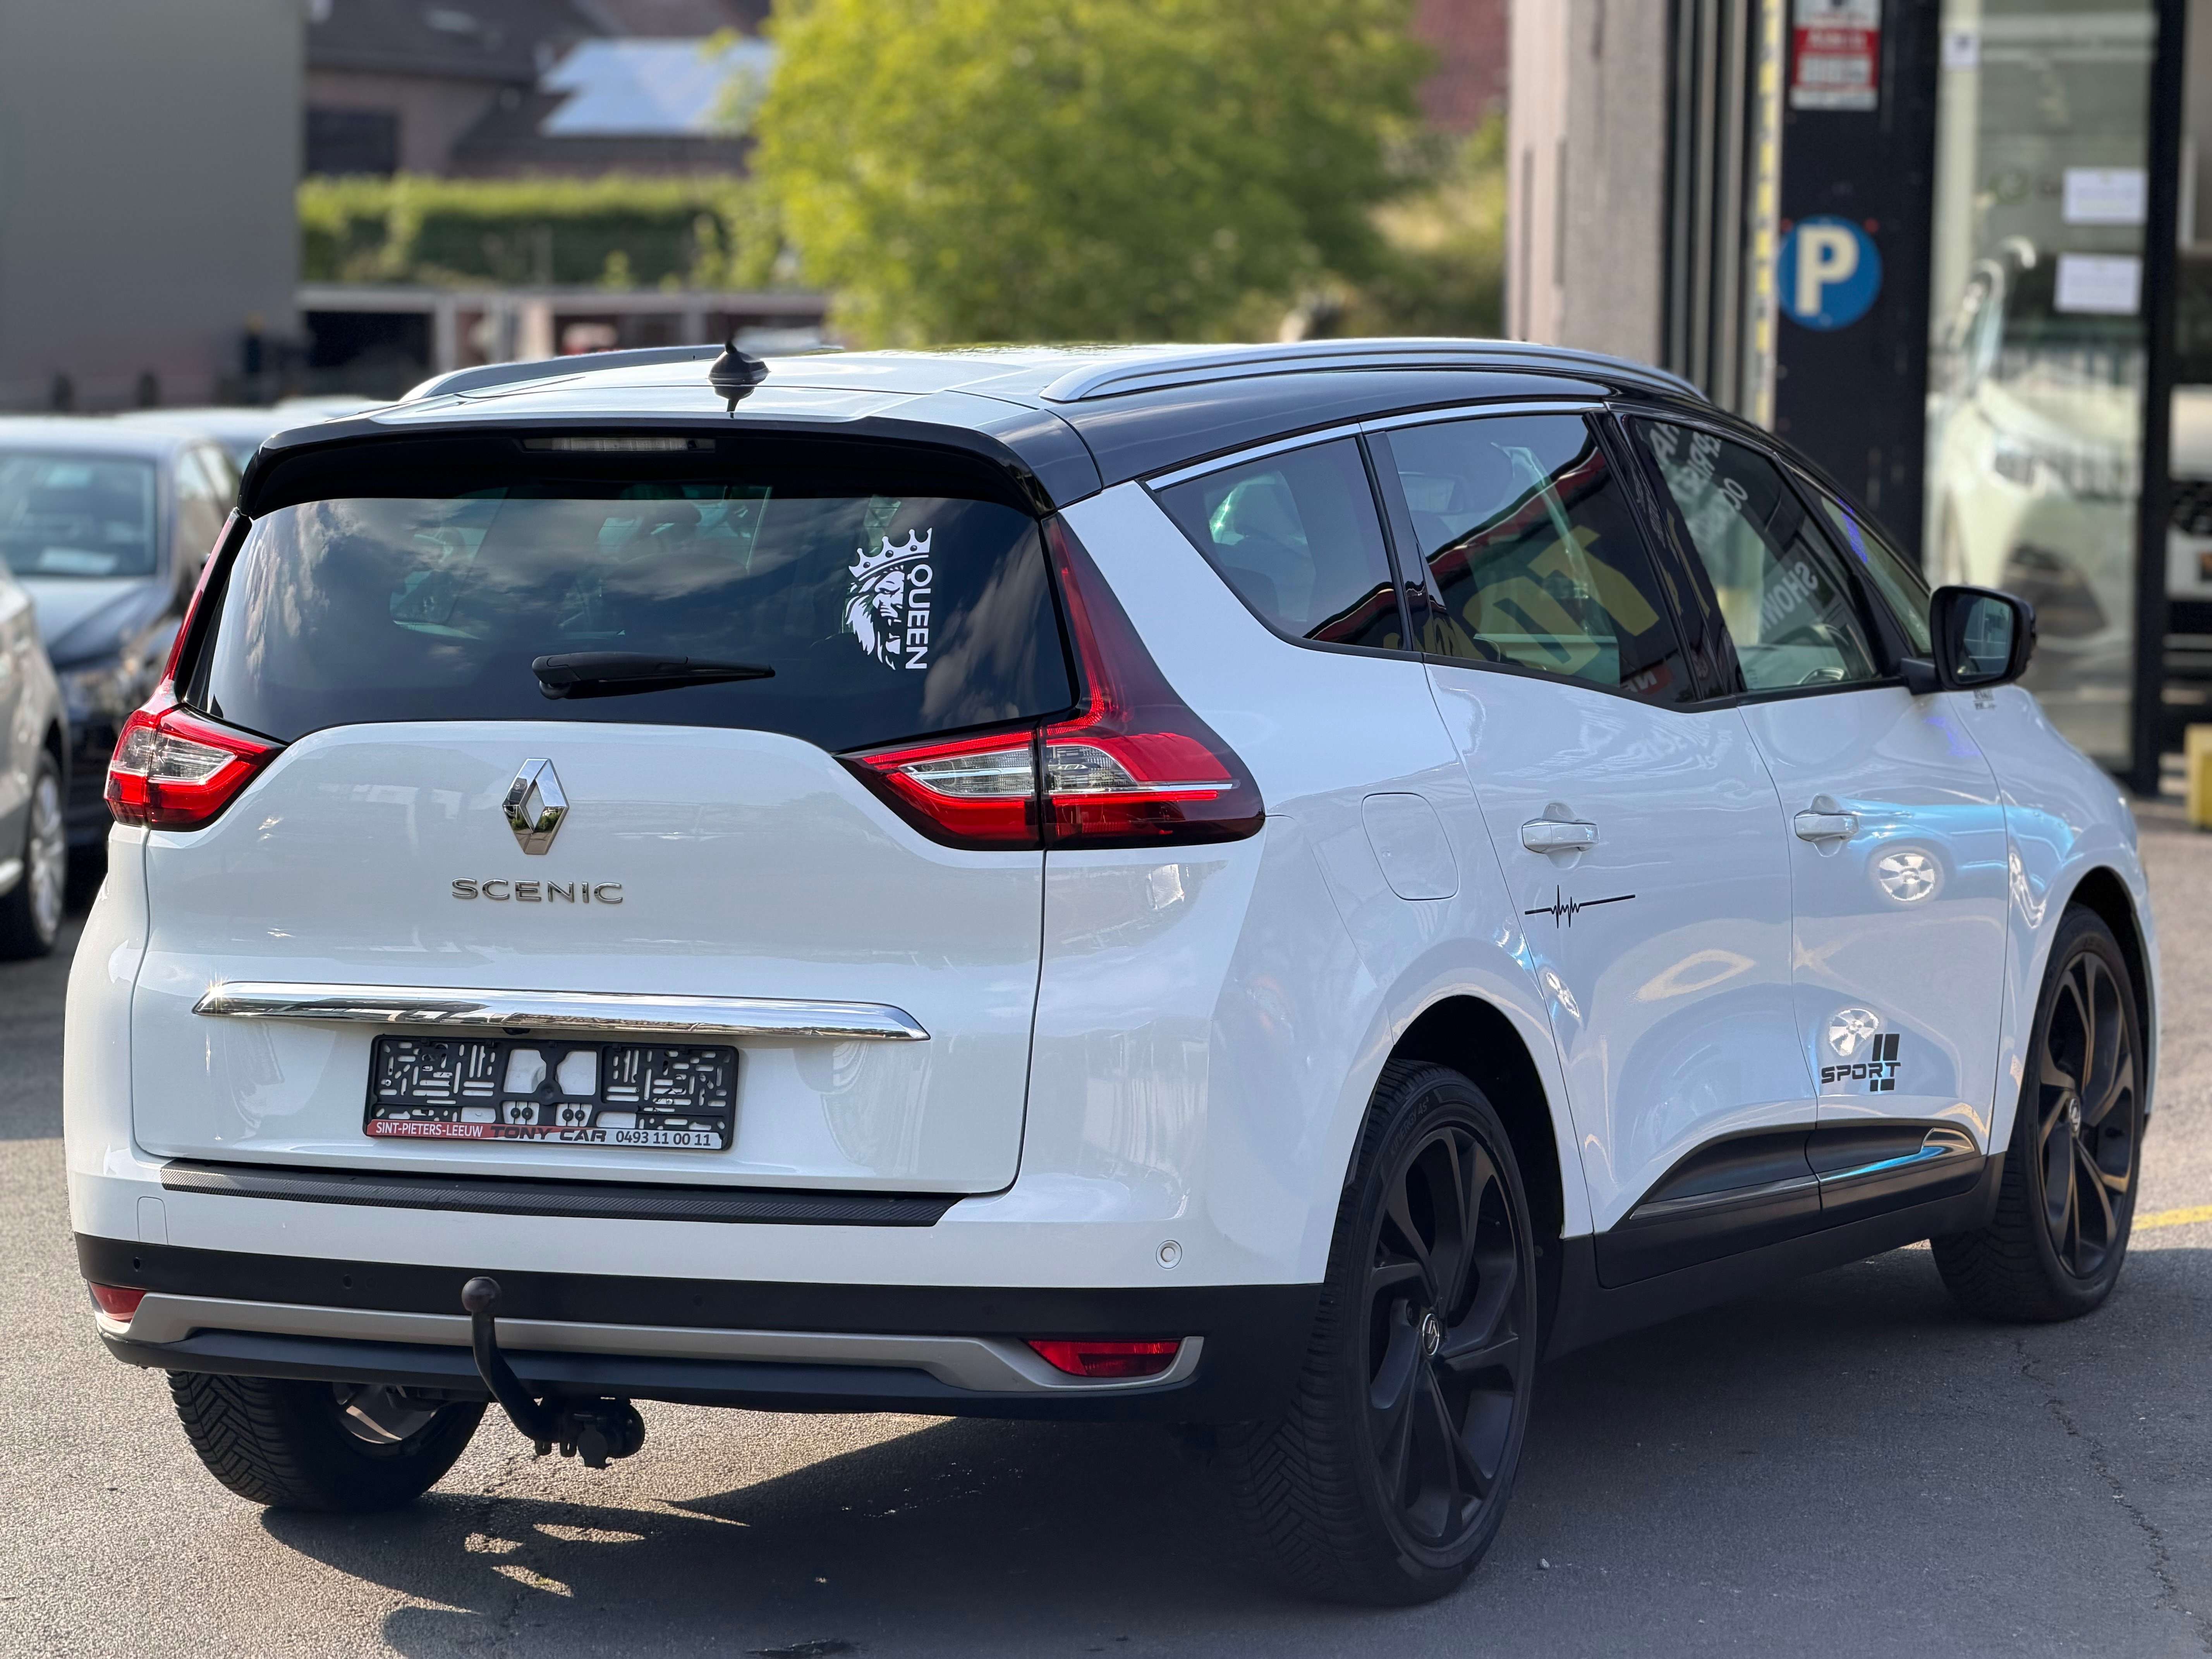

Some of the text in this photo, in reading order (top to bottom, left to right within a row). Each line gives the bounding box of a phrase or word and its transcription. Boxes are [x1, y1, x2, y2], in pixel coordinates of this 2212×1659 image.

[1796, 224, 1860, 316] P
[905, 564, 933, 669] QUEEN
[452, 878, 623, 904] SCENIC
[1821, 1062, 1901, 1084] SPORT
[375, 1122, 711, 1146] SINT-PIETERS-LEEUW TONY CAR 0493 11 00 11
